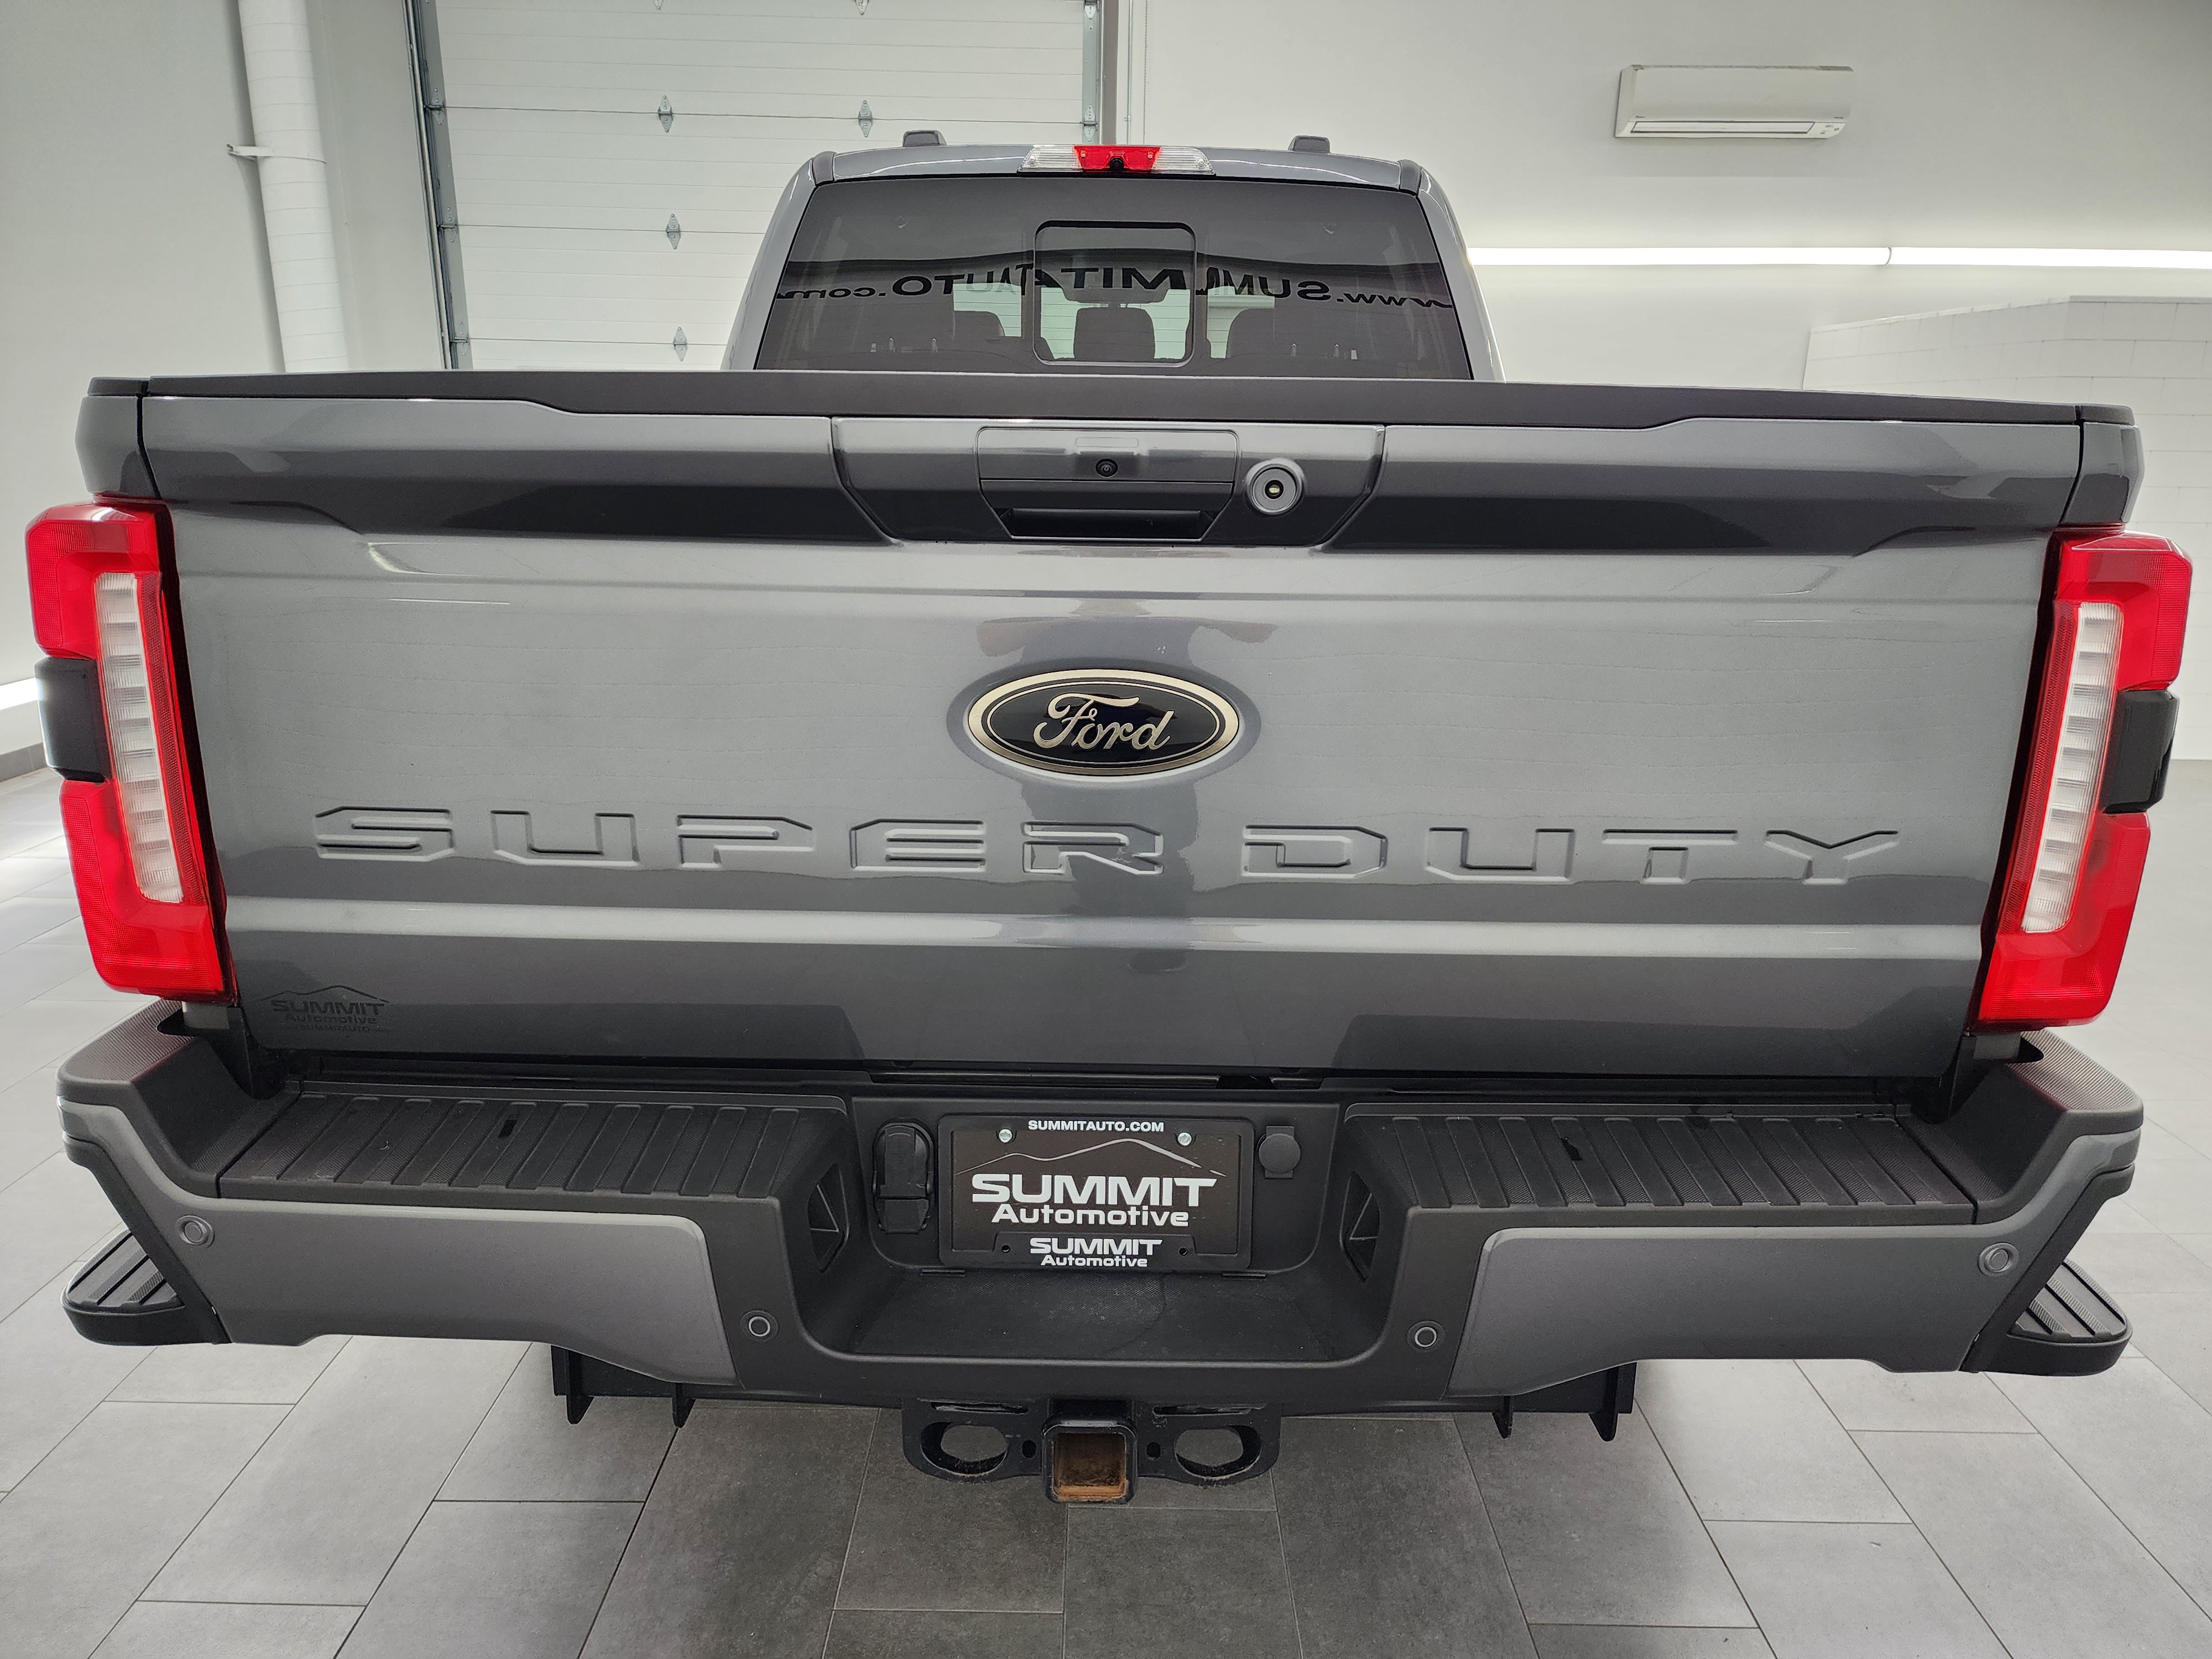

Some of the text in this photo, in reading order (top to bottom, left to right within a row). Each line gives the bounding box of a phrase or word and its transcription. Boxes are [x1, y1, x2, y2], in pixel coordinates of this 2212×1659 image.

[1033, 692, 1175, 751] Ford
[314, 806, 1900, 885] SUPER DUTY
[271, 999, 384, 1015] SUMMIT
[285, 1013, 377, 1024] Automotive
[1027, 1120, 1165, 1133] SUMMITAUTO.COM
[972, 1173, 1217, 1207] SUMMIT
[991, 1203, 1189, 1227] Automotive
[1030, 1238, 1162, 1256] SUMMIT
[1040, 1255, 1148, 1268] Automotive
